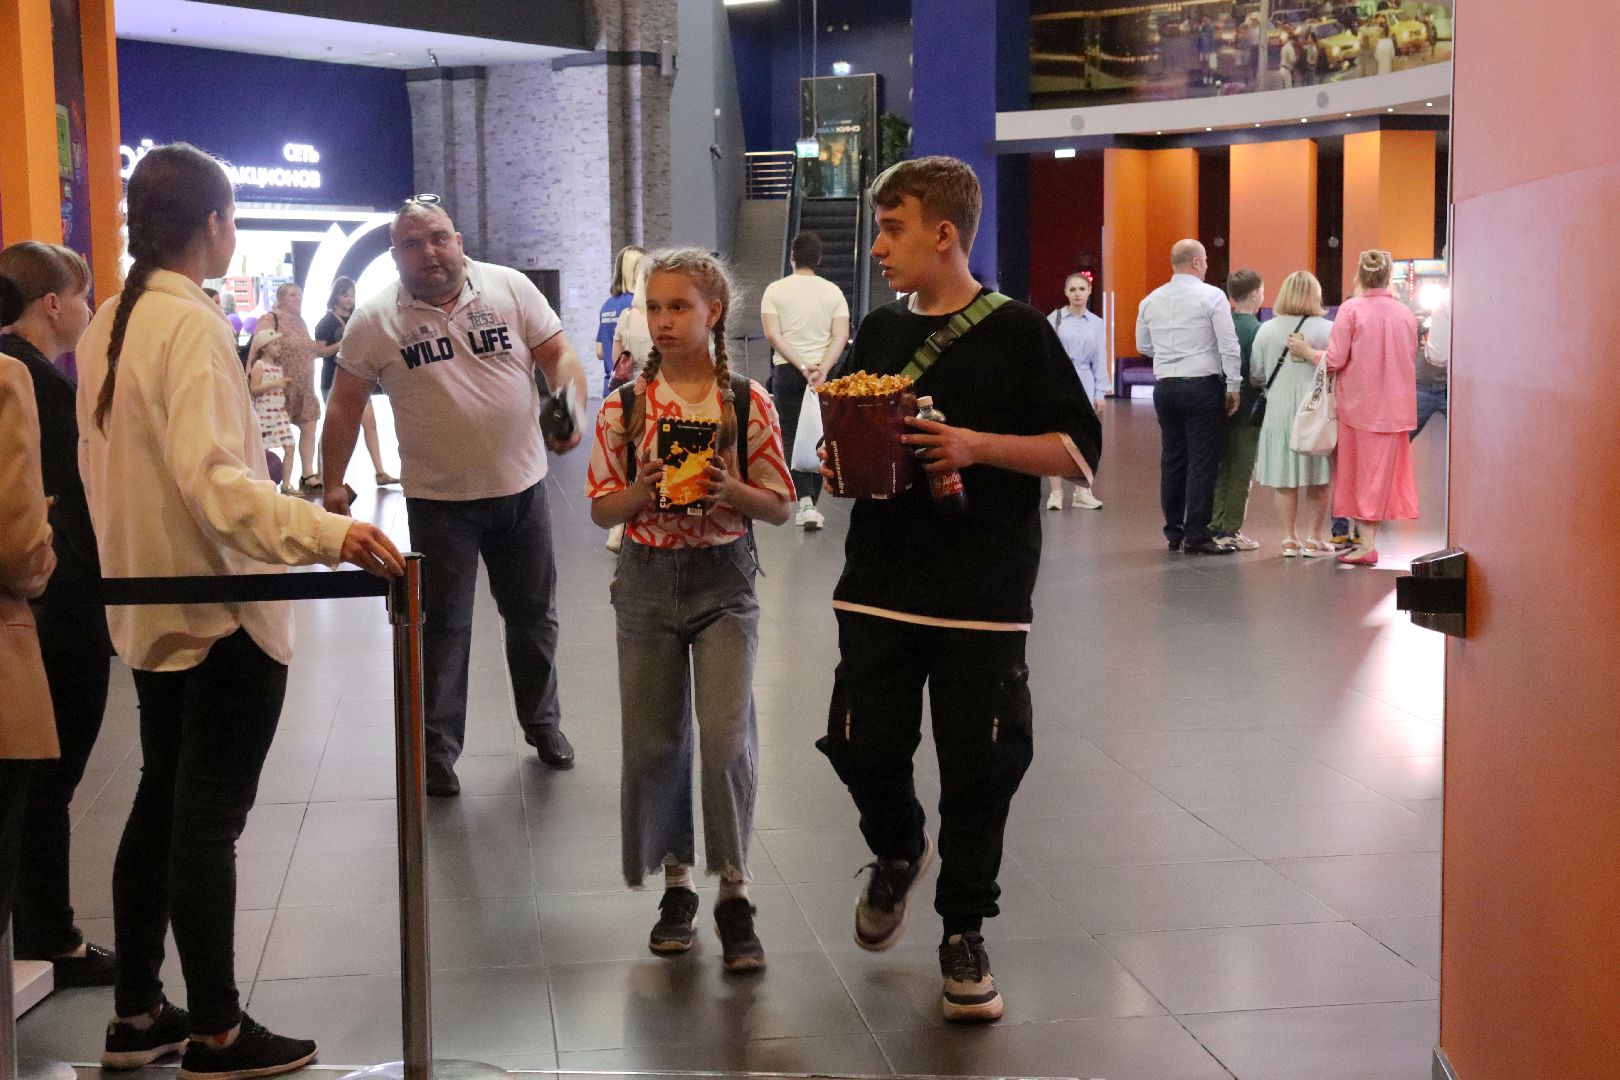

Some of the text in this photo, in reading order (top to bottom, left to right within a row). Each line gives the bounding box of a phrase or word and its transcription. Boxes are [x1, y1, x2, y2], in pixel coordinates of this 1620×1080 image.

[283, 142, 320, 163] СЕТЬ
[228, 166, 321, 189] АКЦИОНОВ
[400, 326, 512, 370] WILD LIFE
[831, 440, 845, 494] карамельный
